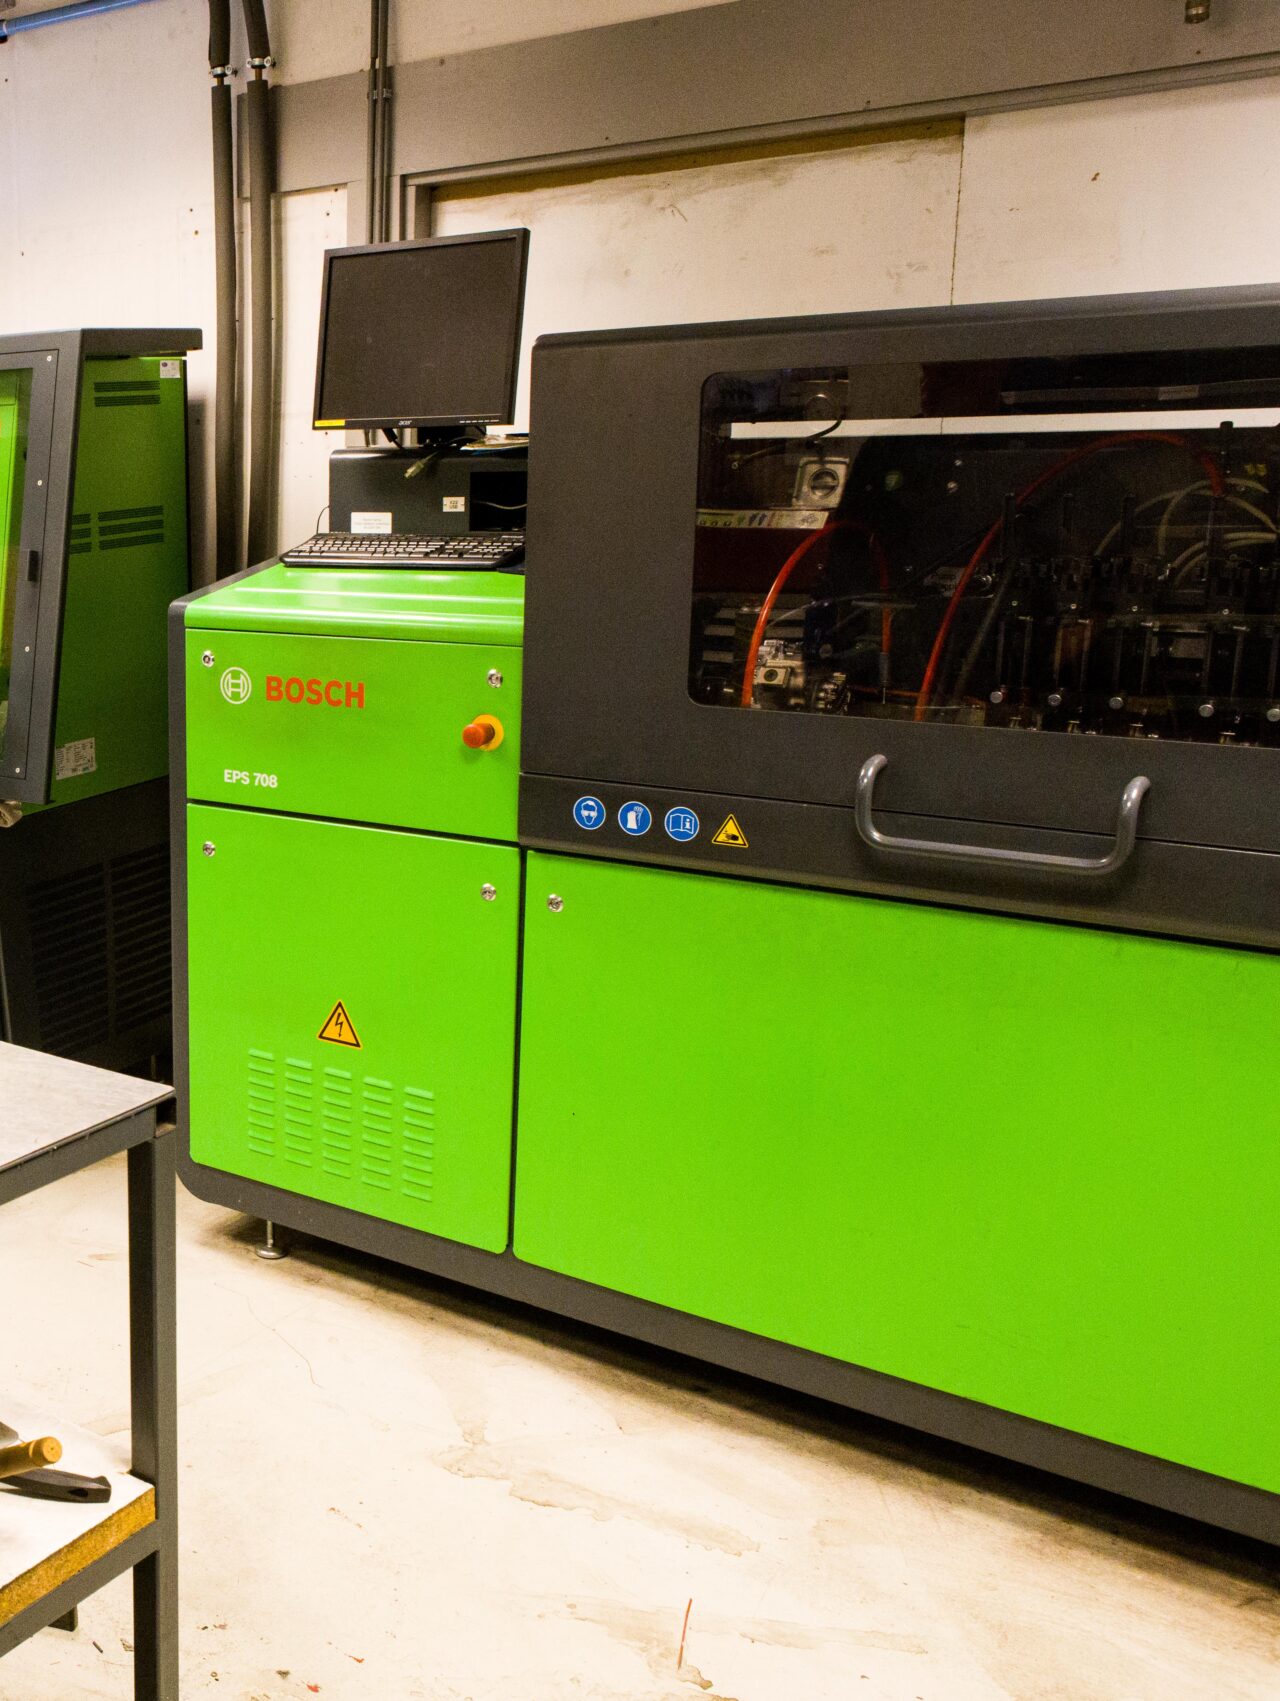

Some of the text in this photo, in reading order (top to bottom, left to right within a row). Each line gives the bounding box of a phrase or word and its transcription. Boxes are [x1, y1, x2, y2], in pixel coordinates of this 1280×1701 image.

[265, 675, 365, 709] BOSCH
[223, 769, 278, 789] EPS 708
